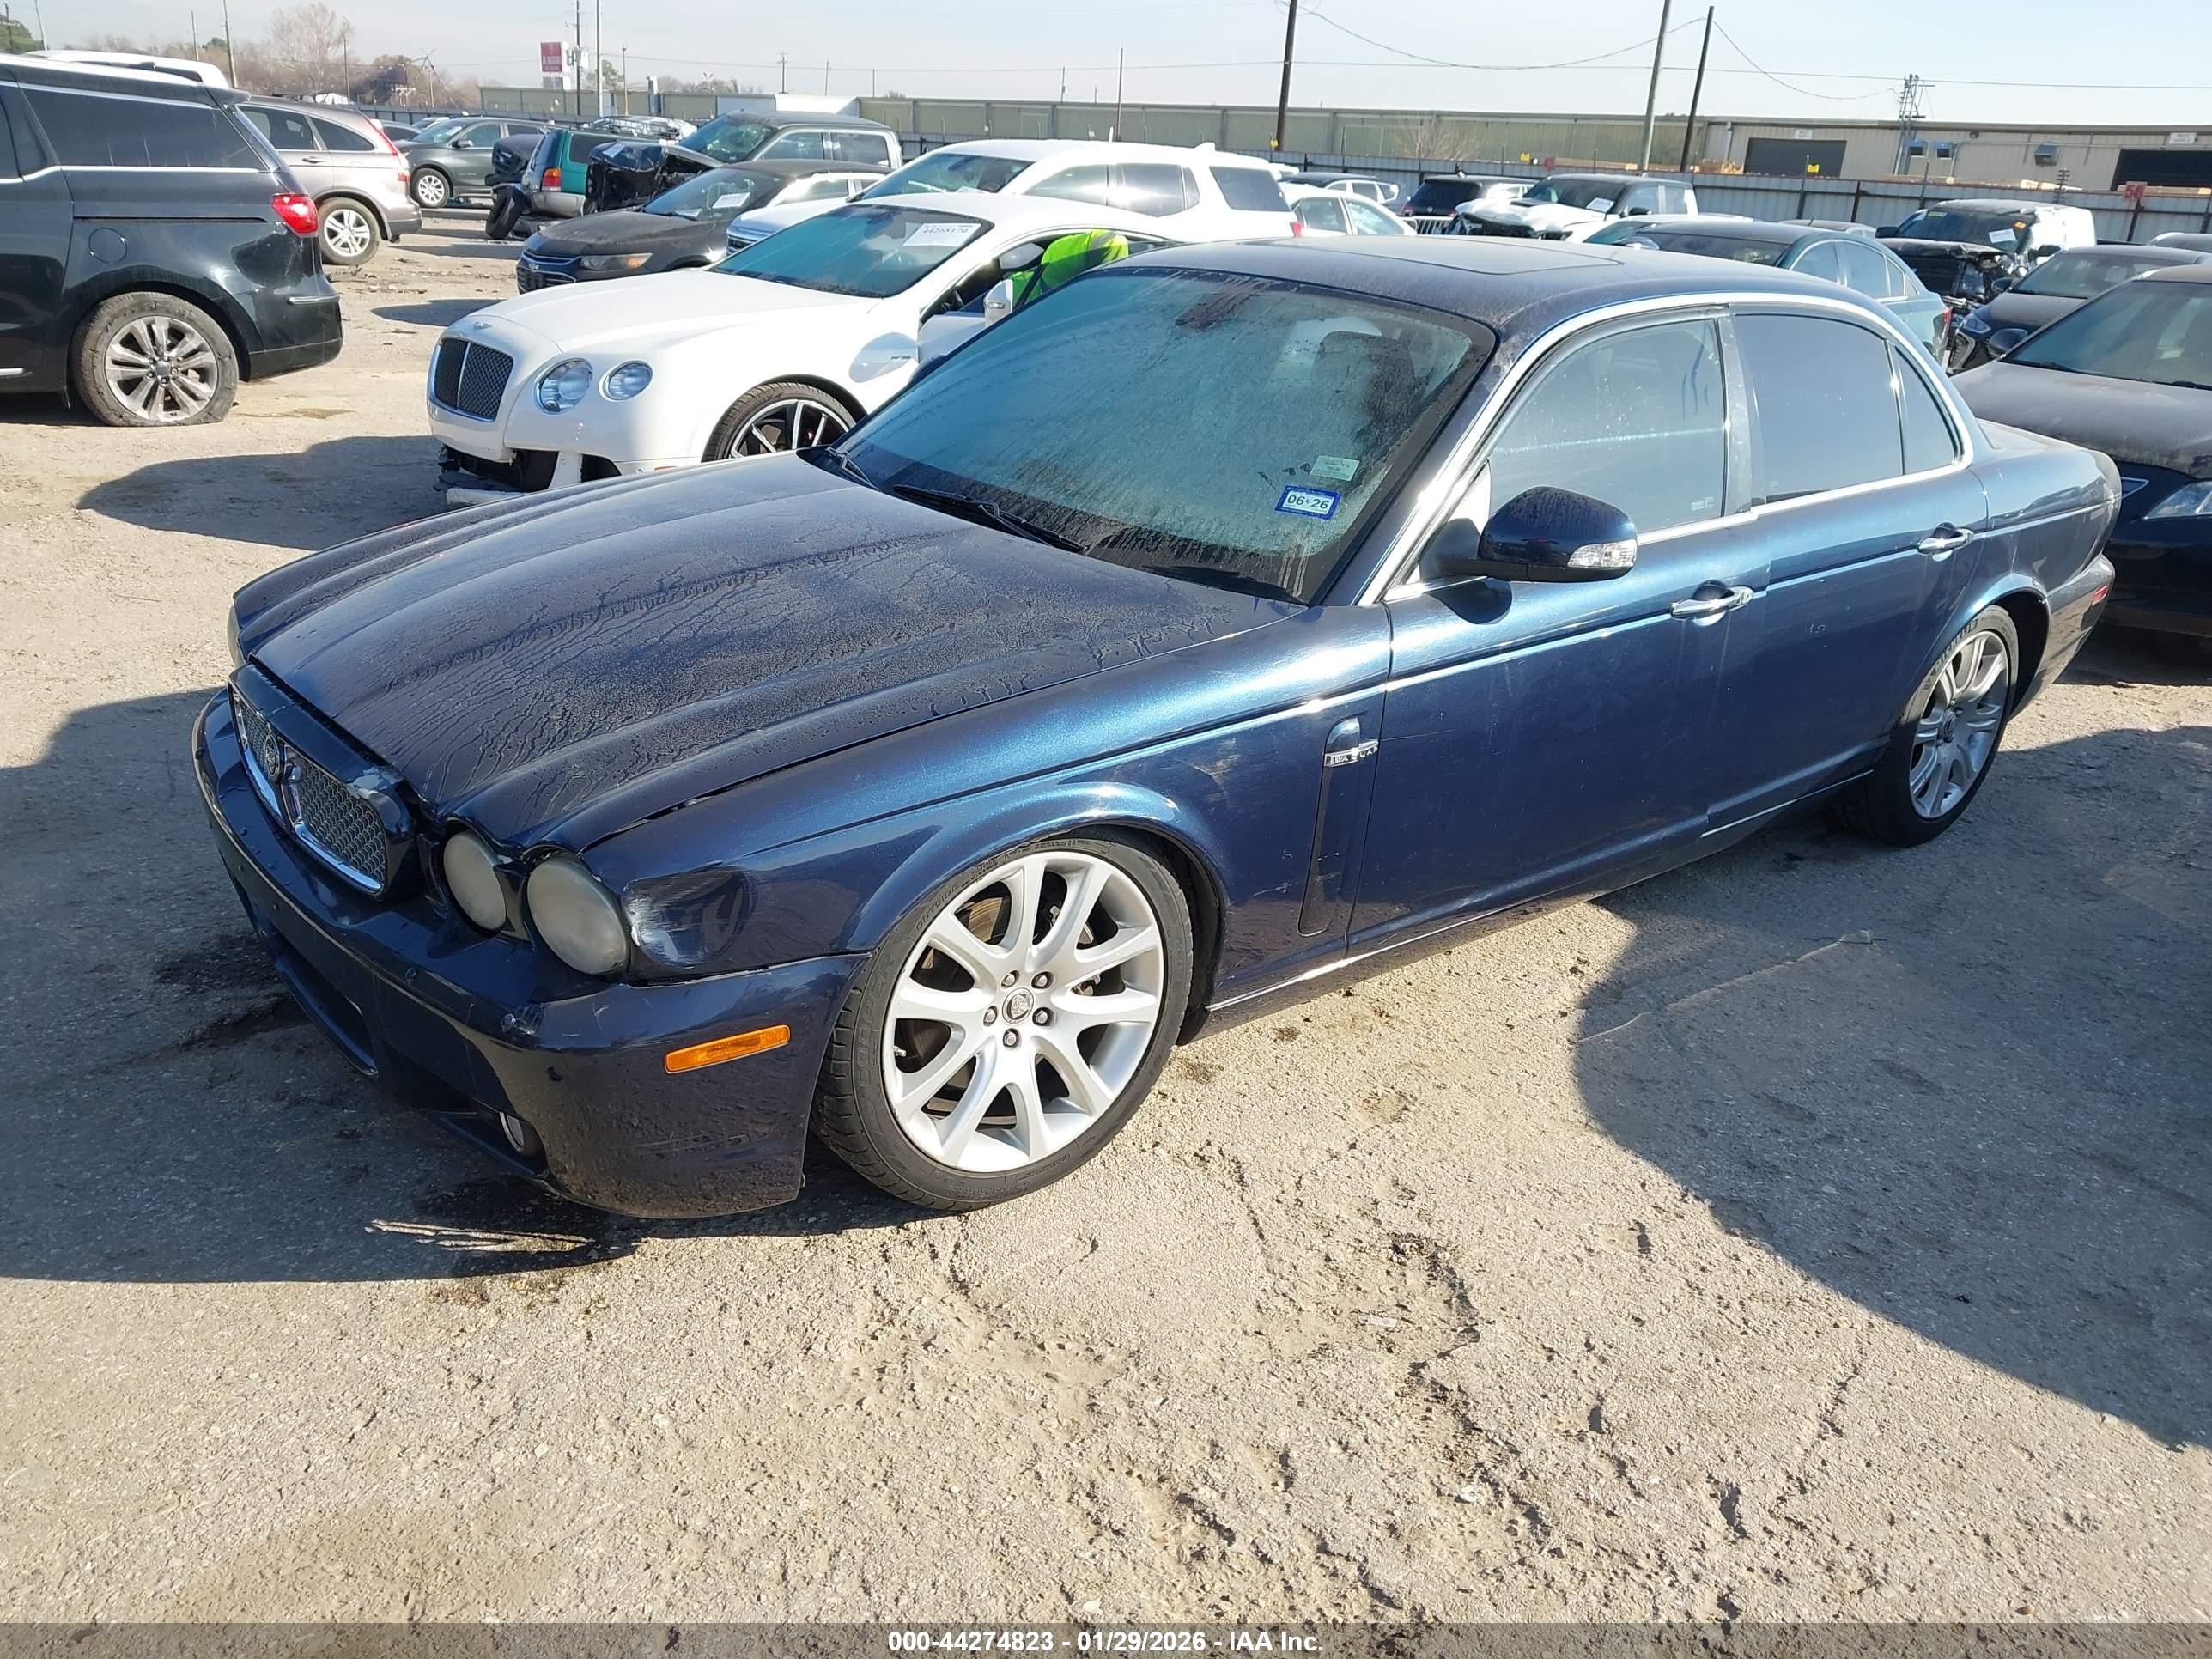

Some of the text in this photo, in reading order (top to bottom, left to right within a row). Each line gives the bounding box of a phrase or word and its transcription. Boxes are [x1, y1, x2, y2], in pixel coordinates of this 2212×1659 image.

[1287, 495, 1329, 509] 06 26
[857, 954, 896, 1087] COOPER
